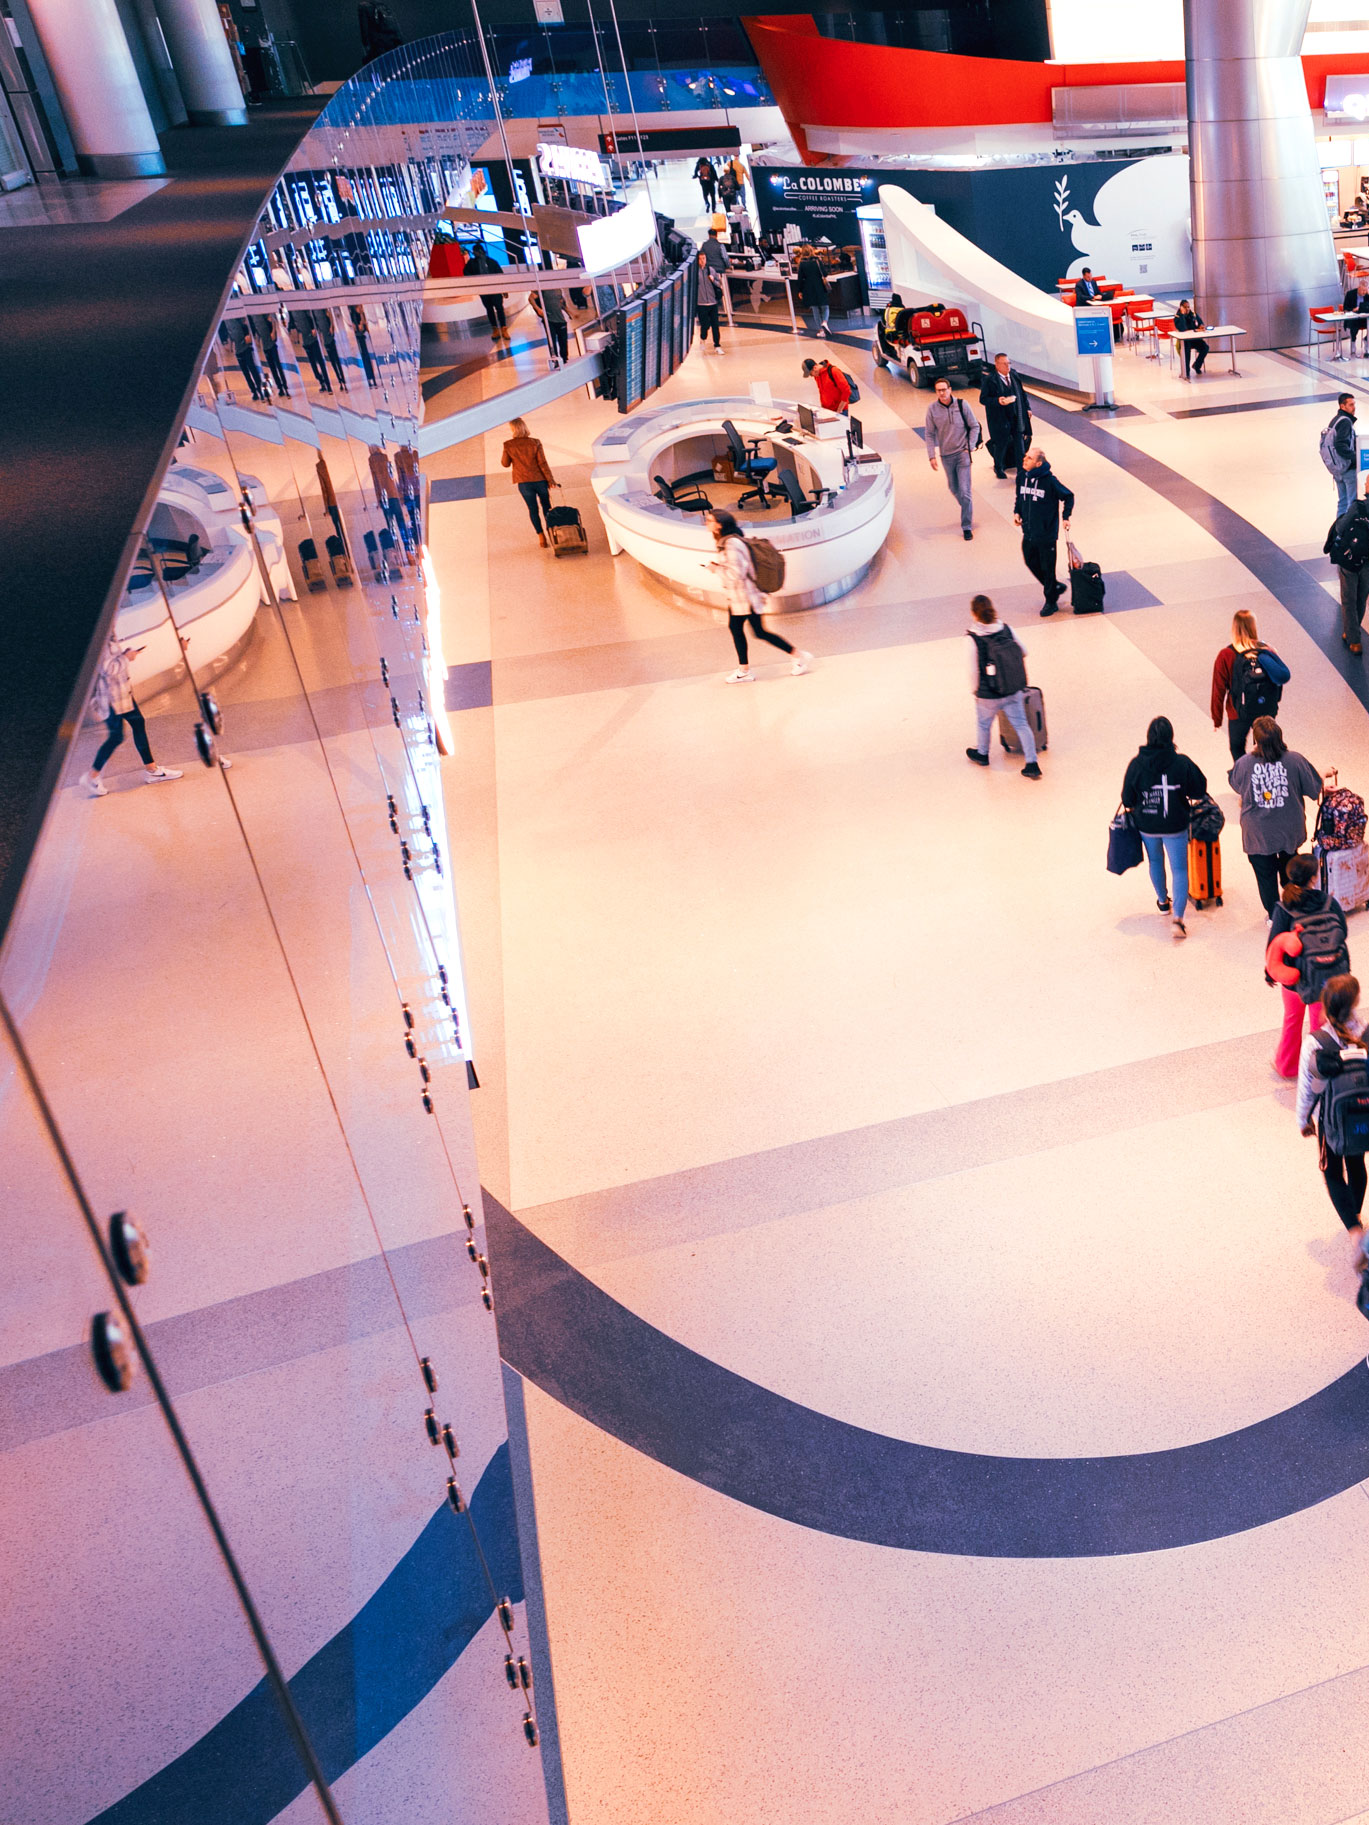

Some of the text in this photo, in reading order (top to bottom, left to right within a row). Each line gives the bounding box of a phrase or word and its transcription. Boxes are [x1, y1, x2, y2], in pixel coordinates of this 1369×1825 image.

[783, 176, 861, 192] La COLOMBE
[1254, 761, 1284, 775] OVER
